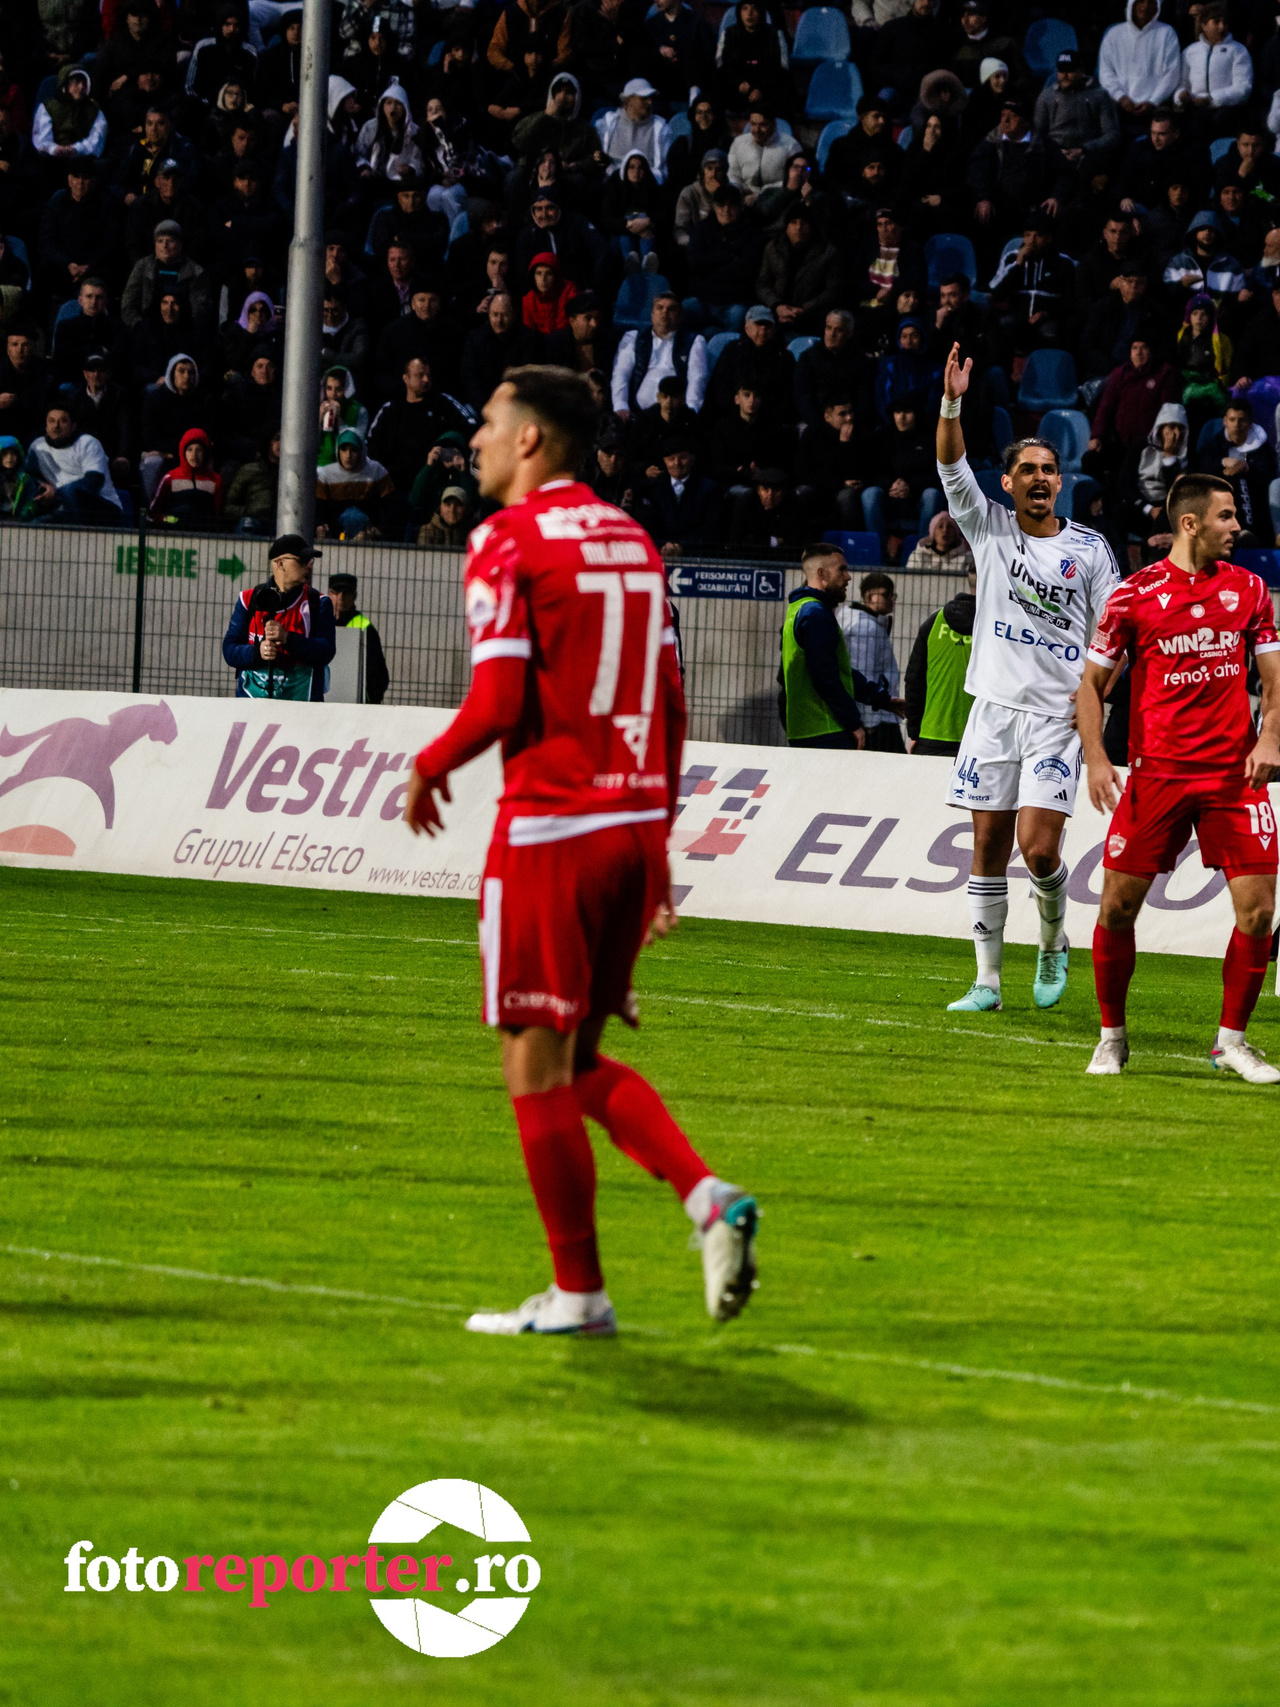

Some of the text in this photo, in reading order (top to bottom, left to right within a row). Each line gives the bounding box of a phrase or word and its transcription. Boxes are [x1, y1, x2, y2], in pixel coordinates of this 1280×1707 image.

[695, 571, 738, 581] PERSOANE
[575, 571, 665, 716] 77
[957, 755, 980, 789] 44
[967, 793, 990, 802] Vestra
[1244, 801, 1275, 834] 18
[173, 828, 365, 878] Grupul Elsaco
[367, 866, 481, 893] www.vestra.ro
